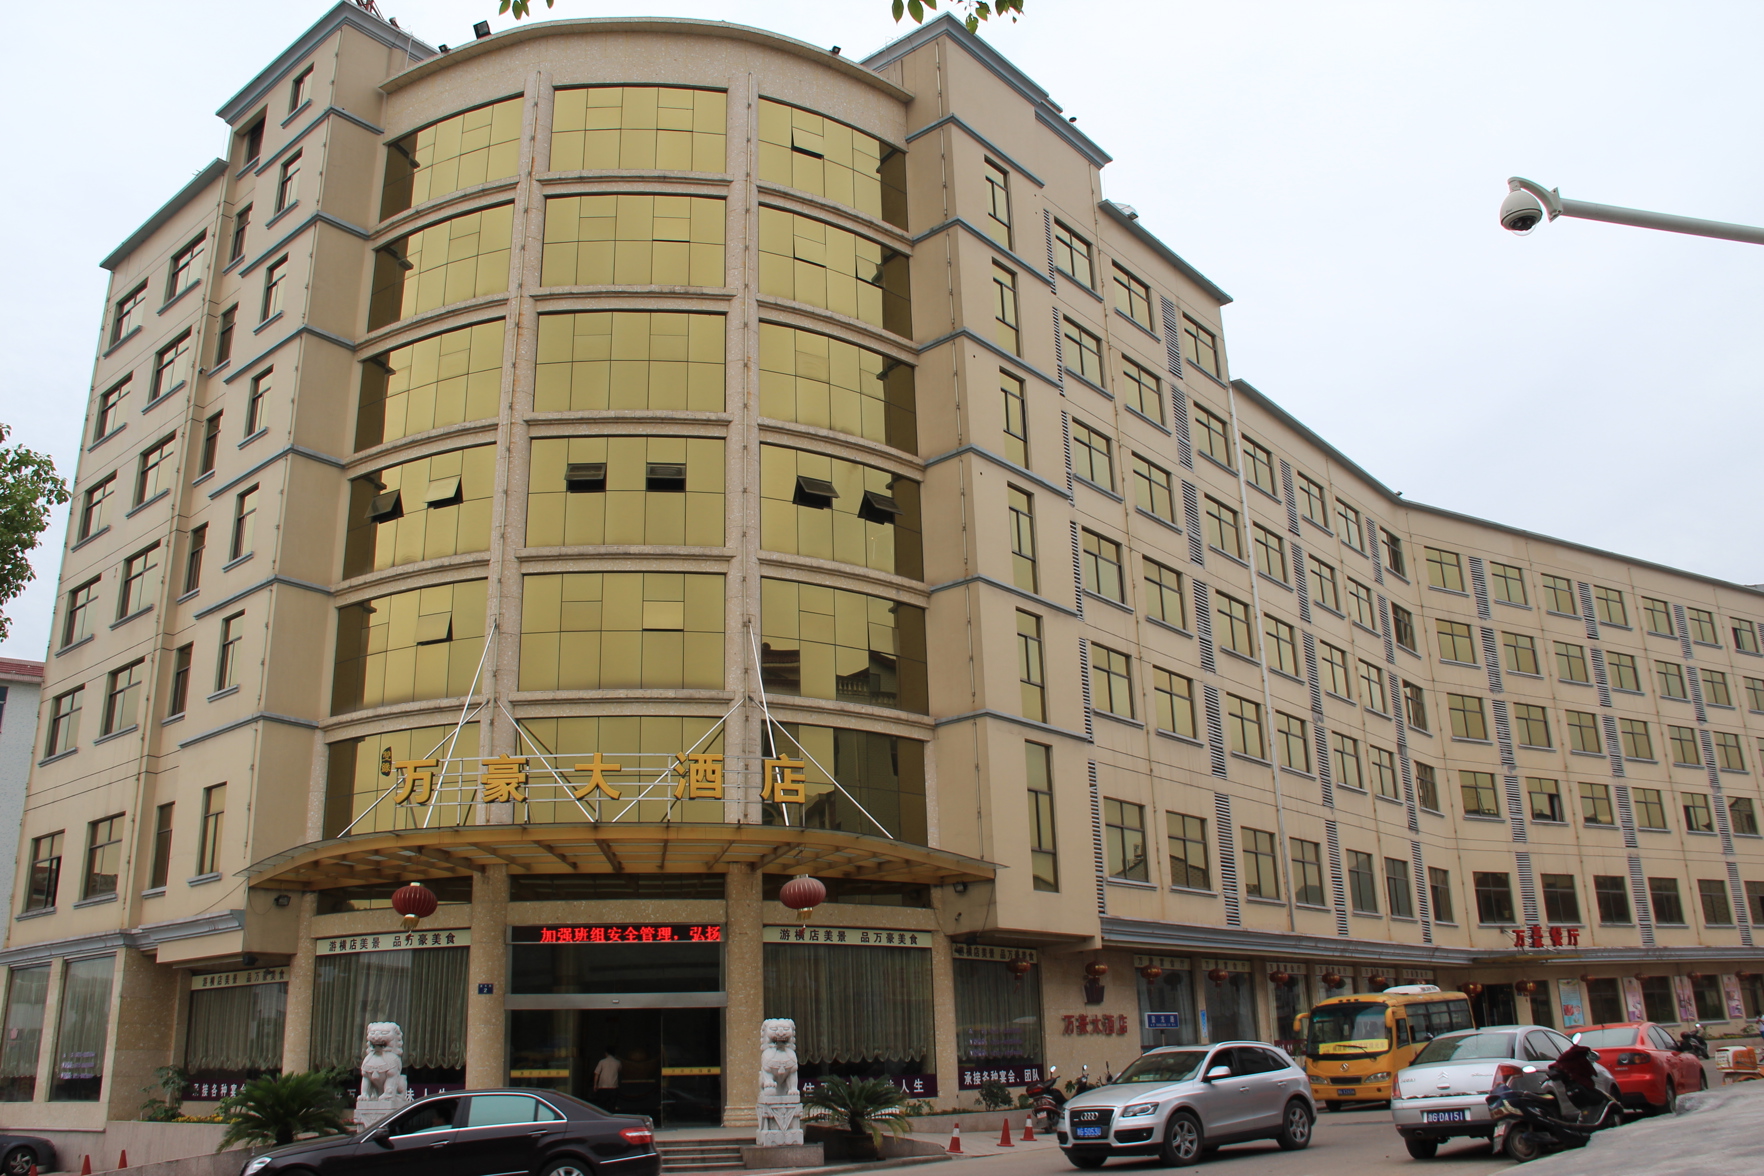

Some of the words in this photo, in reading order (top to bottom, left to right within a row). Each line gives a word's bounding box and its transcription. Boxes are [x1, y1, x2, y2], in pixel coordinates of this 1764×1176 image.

[393, 753, 806, 804] 万豪大酒店
[328, 937, 380, 952] 游横店美景
[392, 932, 456, 947] 品万豪美食
[779, 928, 846, 942] 游横店美景
[860, 931, 918, 945] 品万豪美食
[1512, 925, 1580, 948] 万豪餐厅
[1061, 1014, 1128, 1035] 万豪大酒店
[963, 1068, 1040, 1085] 承接各种宴会、团队
